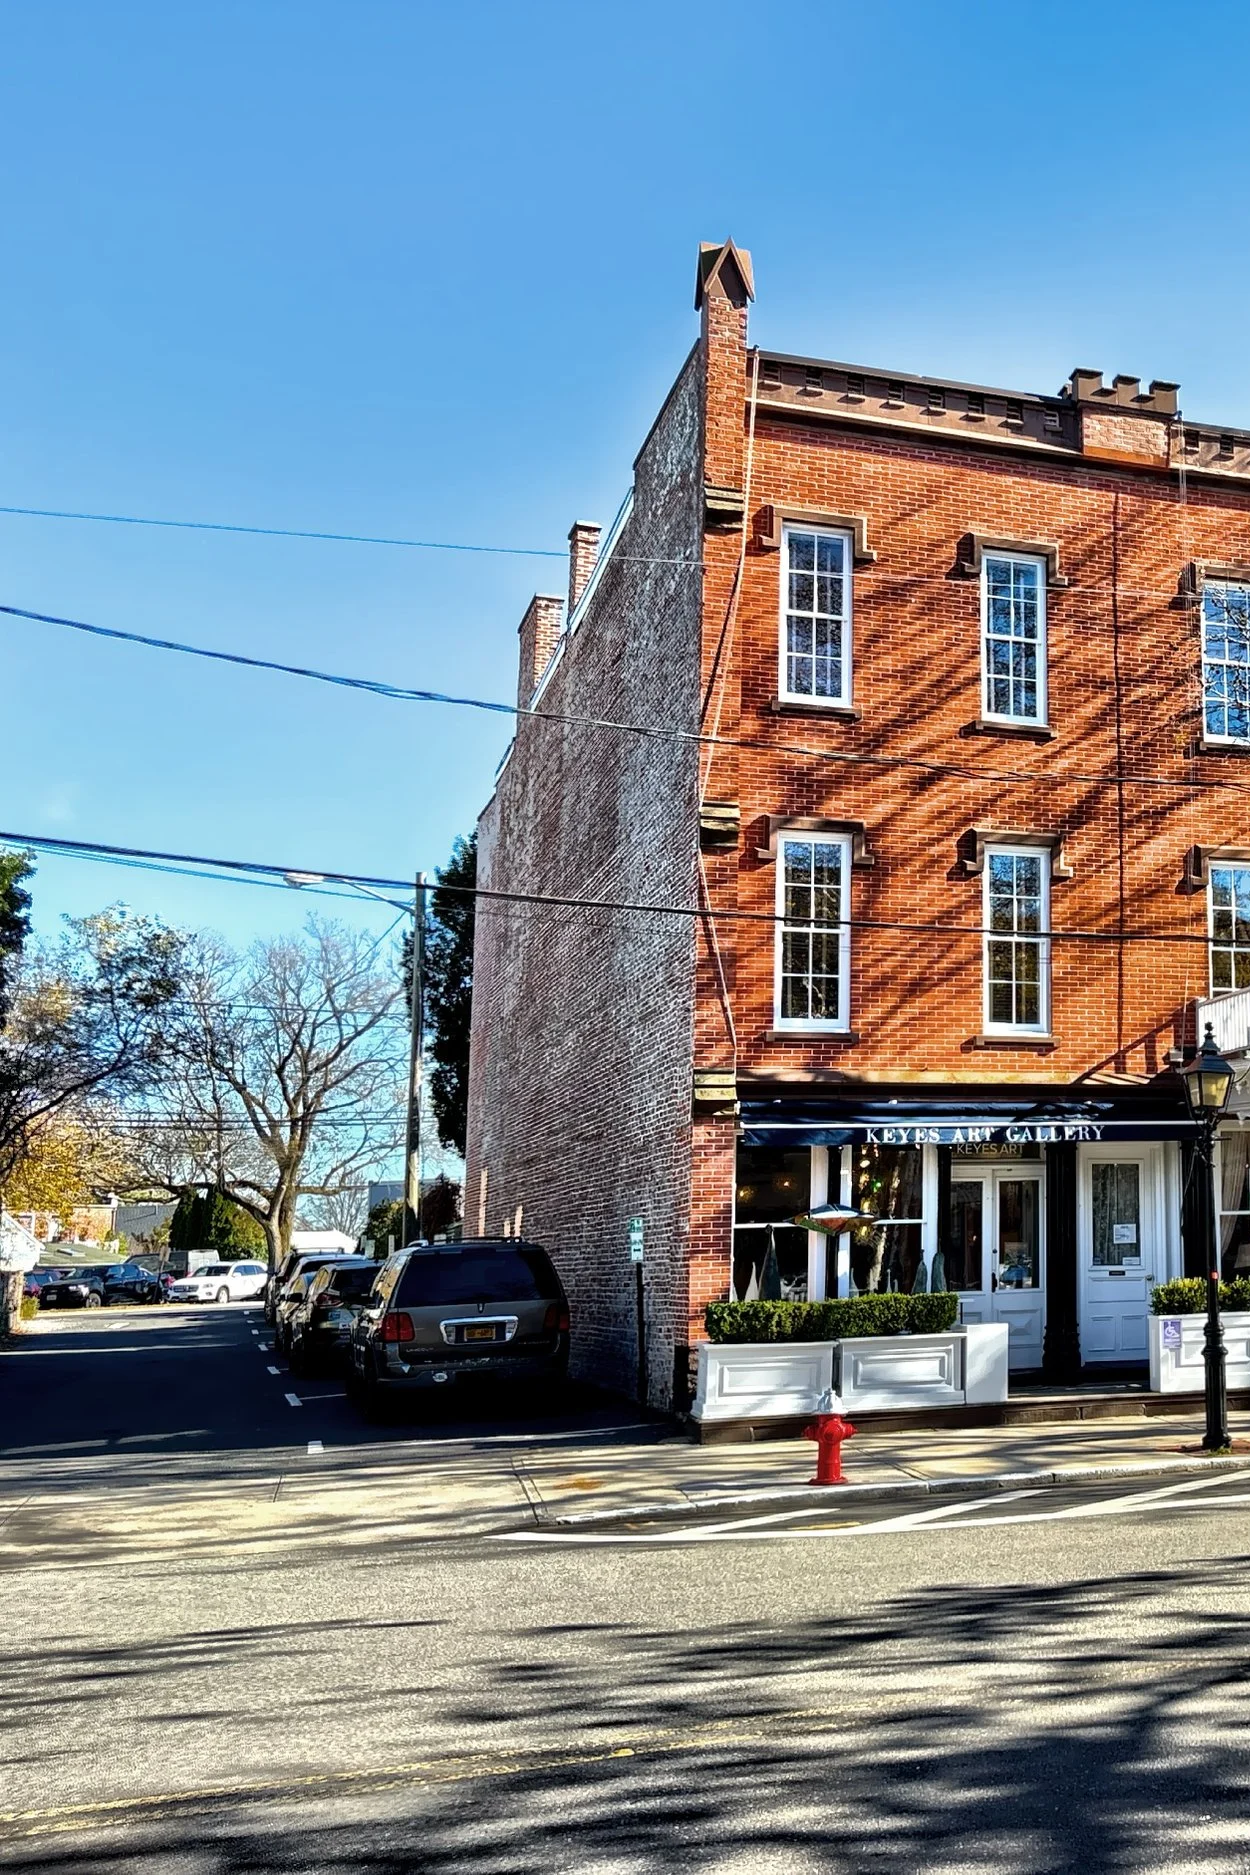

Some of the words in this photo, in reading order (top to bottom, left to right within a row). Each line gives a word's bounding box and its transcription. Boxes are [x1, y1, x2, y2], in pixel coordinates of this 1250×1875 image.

[865, 1127, 941, 1144] KEYES
[951, 1126, 997, 1143] ART
[1005, 1125, 1105, 1143] GALLERY
[956, 1142, 998, 1155] KEYES
[999, 1142, 1025, 1155] ART
